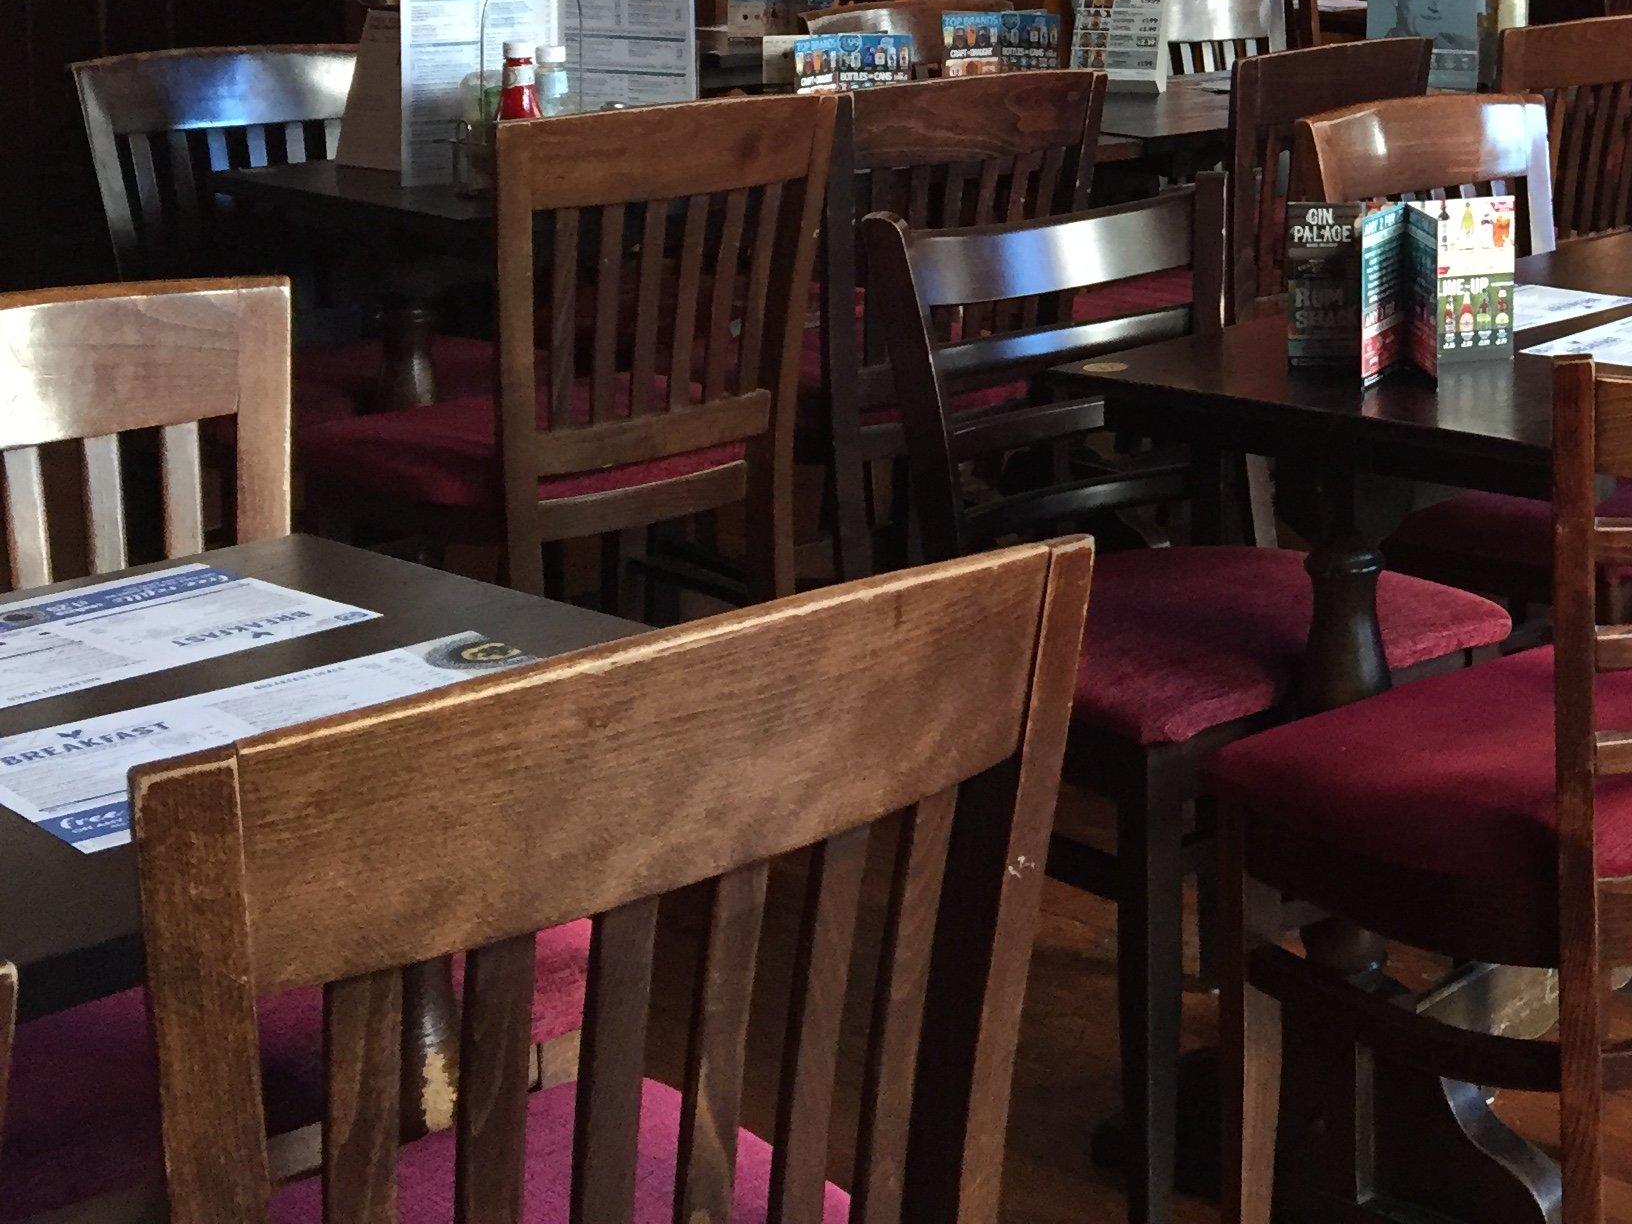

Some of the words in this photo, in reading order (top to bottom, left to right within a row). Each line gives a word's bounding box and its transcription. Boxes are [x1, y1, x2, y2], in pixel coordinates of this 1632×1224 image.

[963, 15, 998, 25] BRANDS
[1306, 208, 1335, 225] GIN
[1292, 225, 1351, 243] PALACE
[1438, 277, 1489, 296] LINE-UP
[172, 610, 312, 648] BREAKFAST
[1, 722, 169, 766] BREAKFAST
